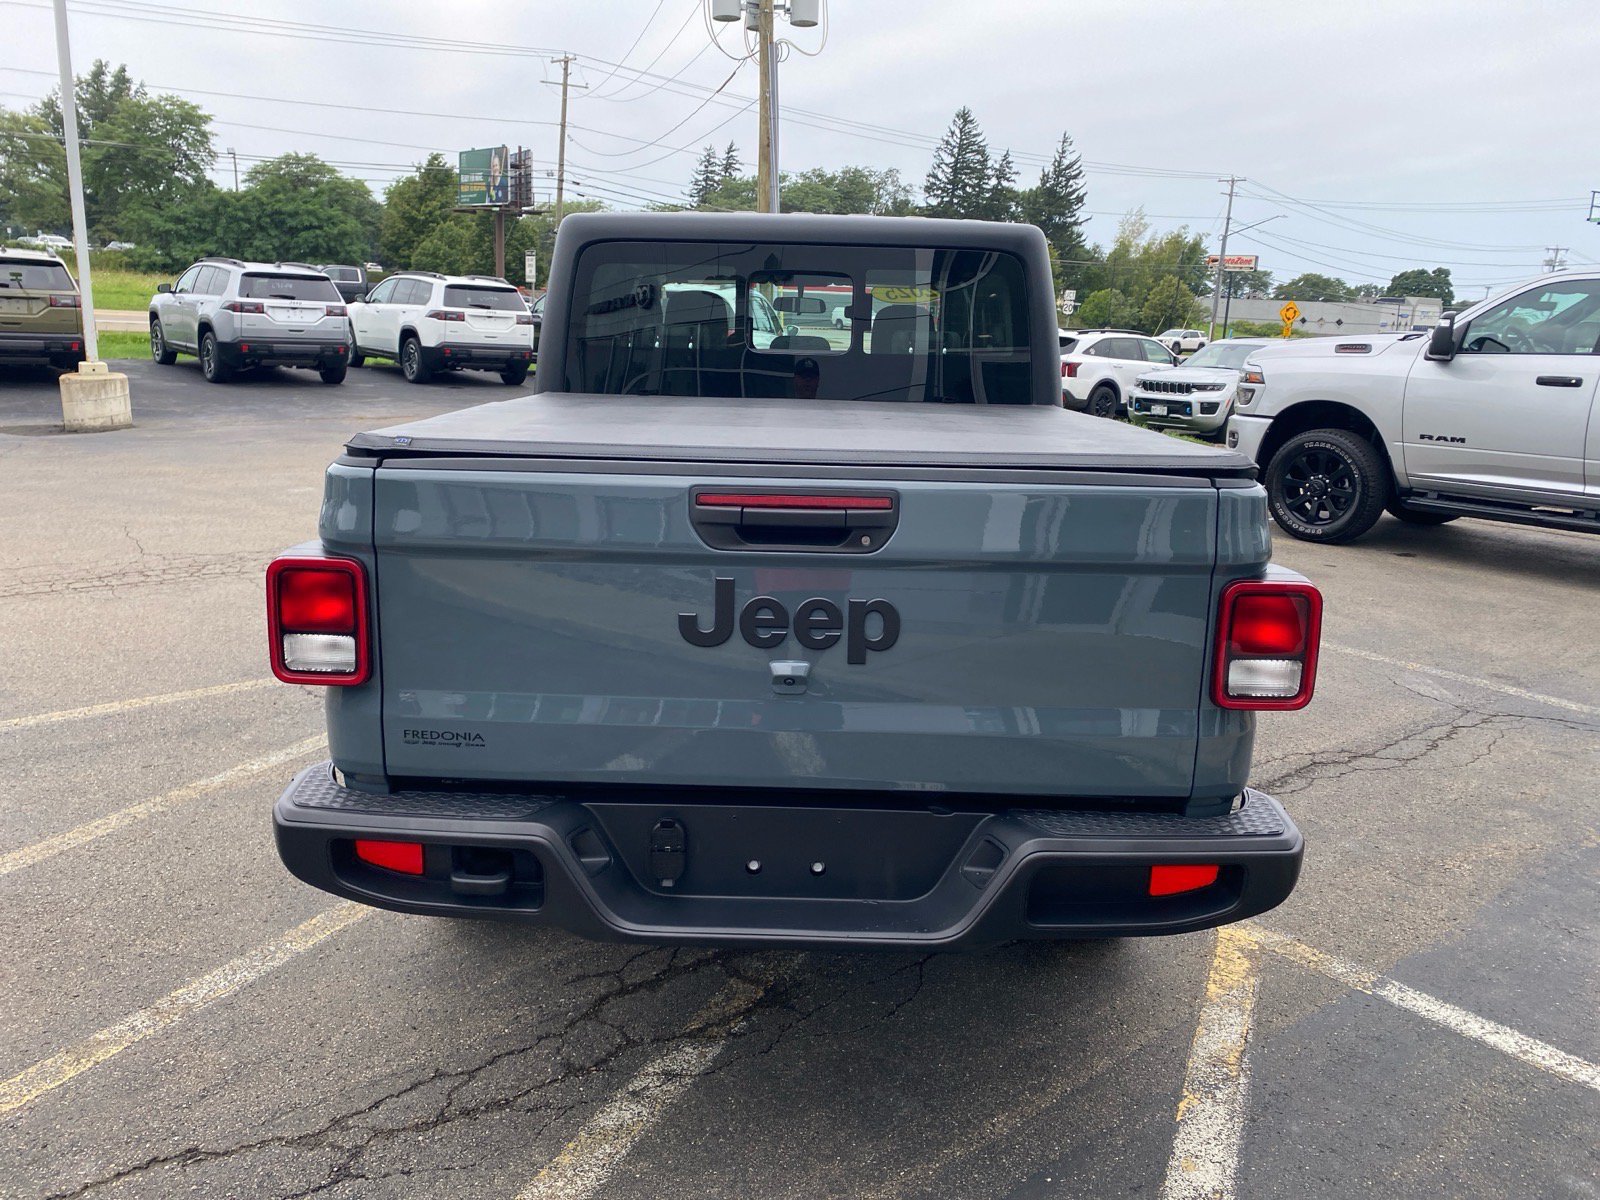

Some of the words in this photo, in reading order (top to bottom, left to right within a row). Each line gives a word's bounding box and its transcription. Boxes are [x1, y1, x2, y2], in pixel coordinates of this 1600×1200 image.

[1063, 303, 1073, 312] 20
[1419, 434, 1466, 444] RAM
[678, 577, 901, 664] Jeep
[403, 729, 485, 742] FREDONIA
